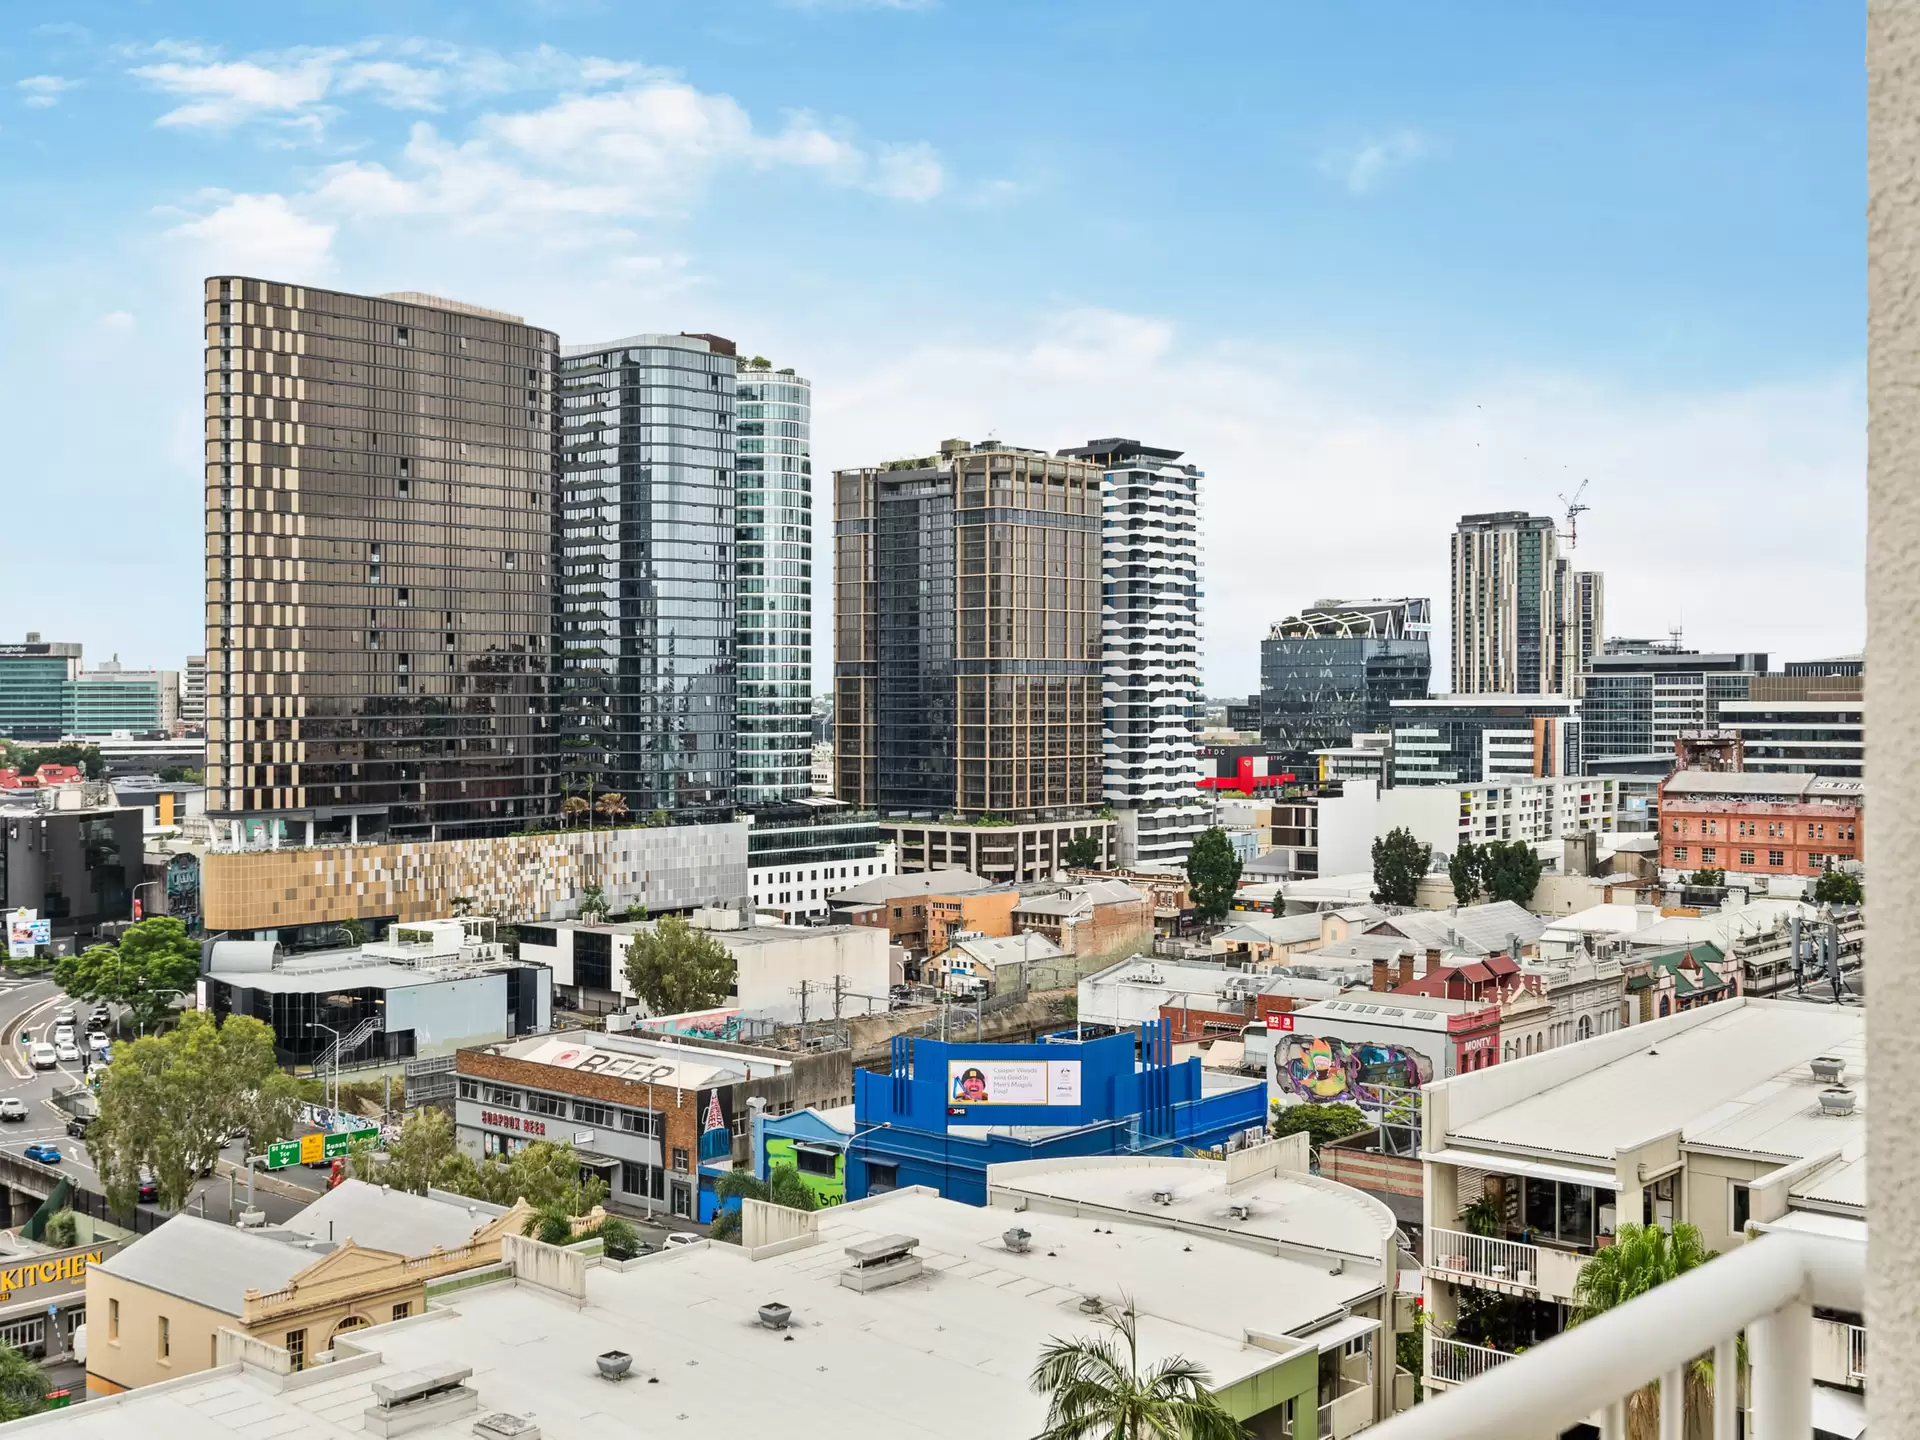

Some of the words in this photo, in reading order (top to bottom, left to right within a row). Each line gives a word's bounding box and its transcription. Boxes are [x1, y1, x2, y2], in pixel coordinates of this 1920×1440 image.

[1465, 1036, 1491, 1052] MONTY
[574, 1053, 675, 1083] BEER
[993, 1067, 1015, 1075] Cooper
[481, 1110, 520, 1130] SOAPBOX
[523, 1119, 546, 1136] BEER
[271, 1144, 279, 1152] St
[280, 1142, 298, 1150] Pauls
[1, 1251, 103, 1292] KITCHEN
